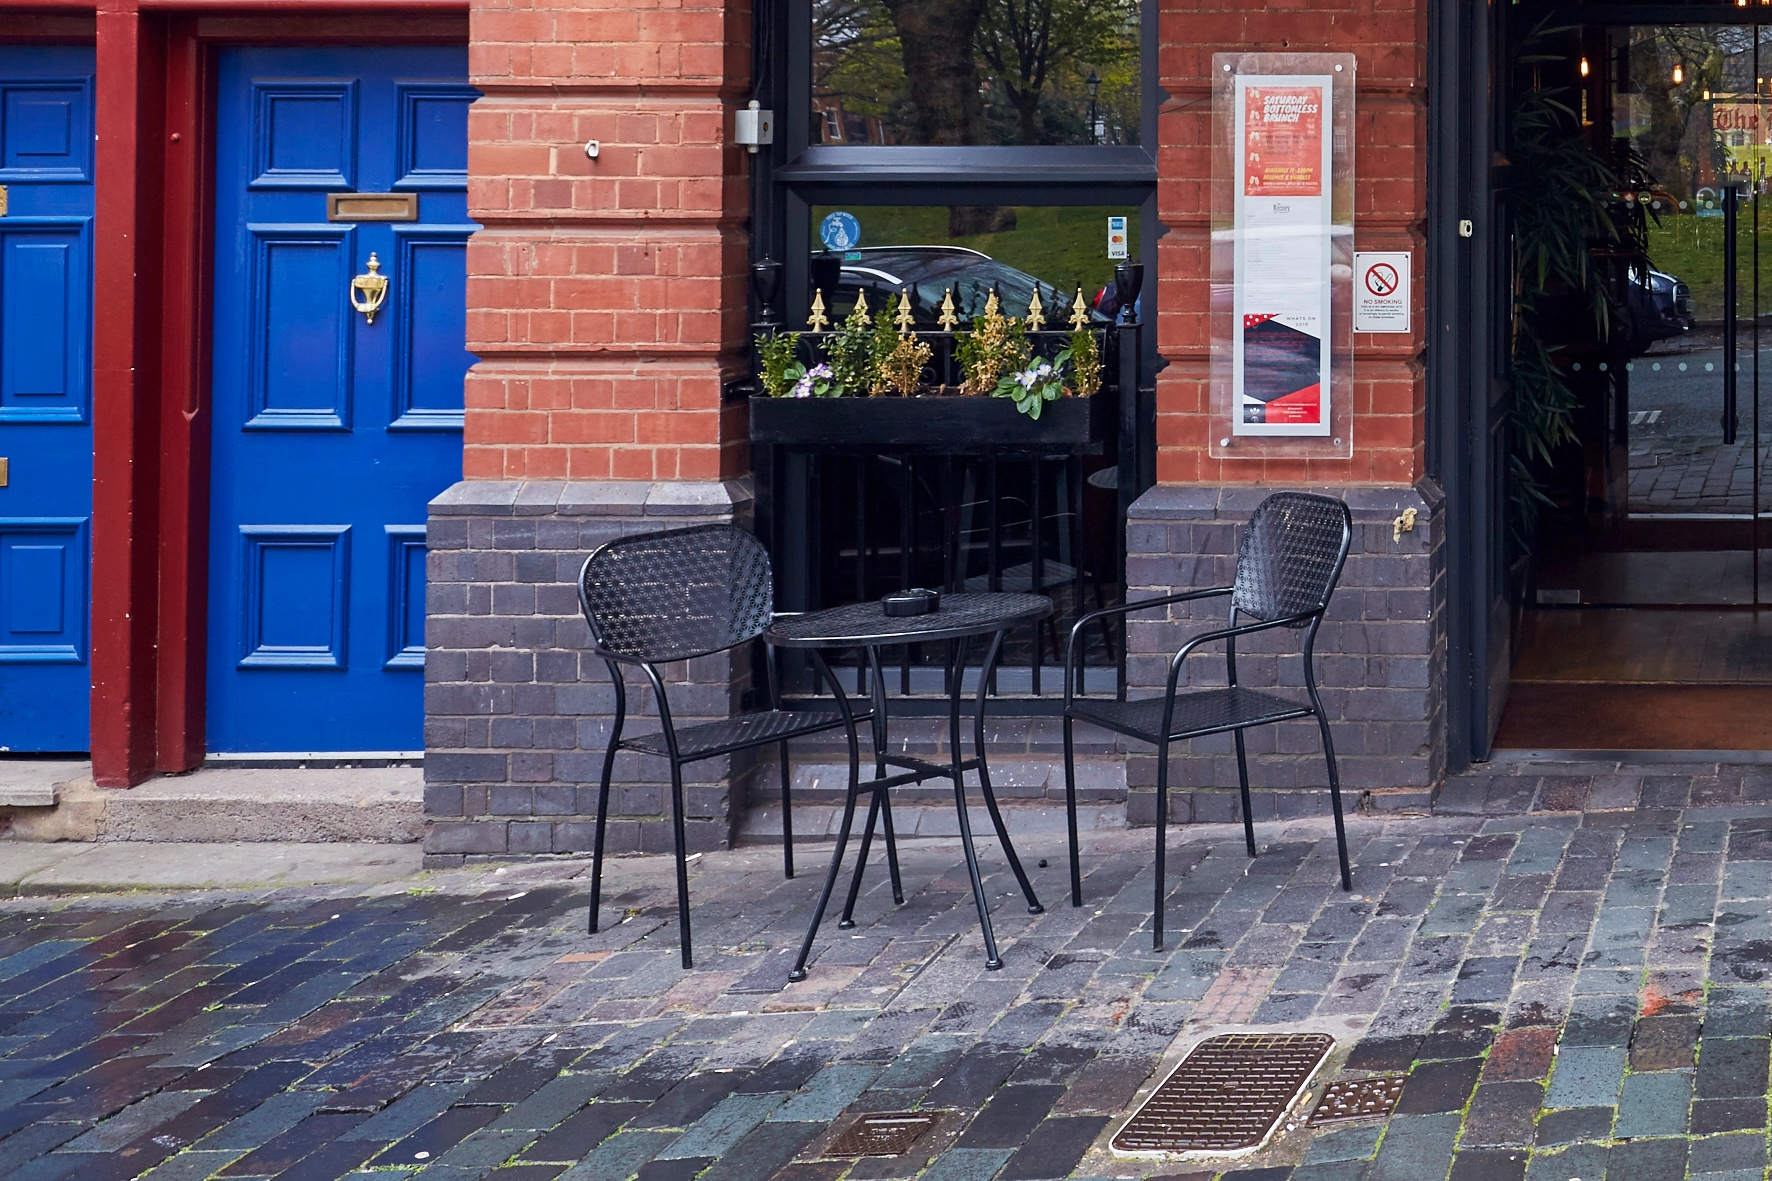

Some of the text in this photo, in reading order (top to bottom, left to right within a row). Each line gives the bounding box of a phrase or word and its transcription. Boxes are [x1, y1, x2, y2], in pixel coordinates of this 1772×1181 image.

[1263, 95, 1308, 105] SATURDAY
[1263, 104, 1318, 114] BOTTOMLESS
[1263, 113, 1300, 123] BRUNCH
[1713, 107, 1759, 131] The
